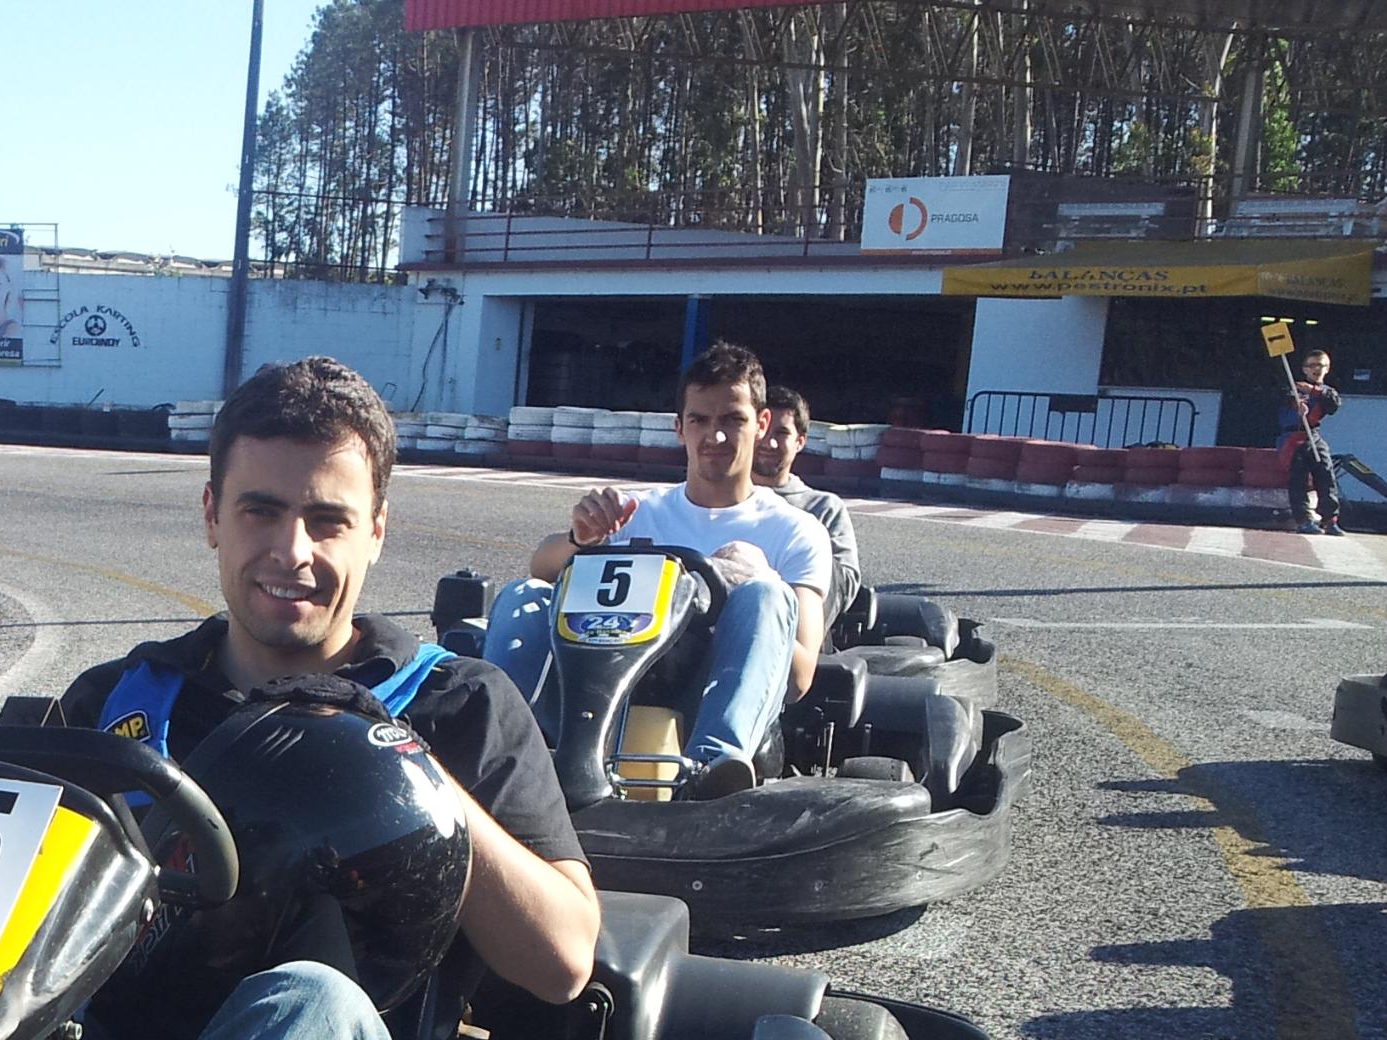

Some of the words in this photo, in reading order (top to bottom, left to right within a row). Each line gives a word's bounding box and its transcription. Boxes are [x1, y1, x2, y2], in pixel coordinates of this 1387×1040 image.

[931, 213, 979, 223] PRAGOSA
[991, 282, 1207, 294] www.pestronix.pt
[49, 305, 89, 345] ESCOLA
[96, 304, 141, 348] KARTING
[72, 336, 121, 347] EUROINDY
[596, 560, 634, 608] 5
[587, 616, 620, 630] 24
